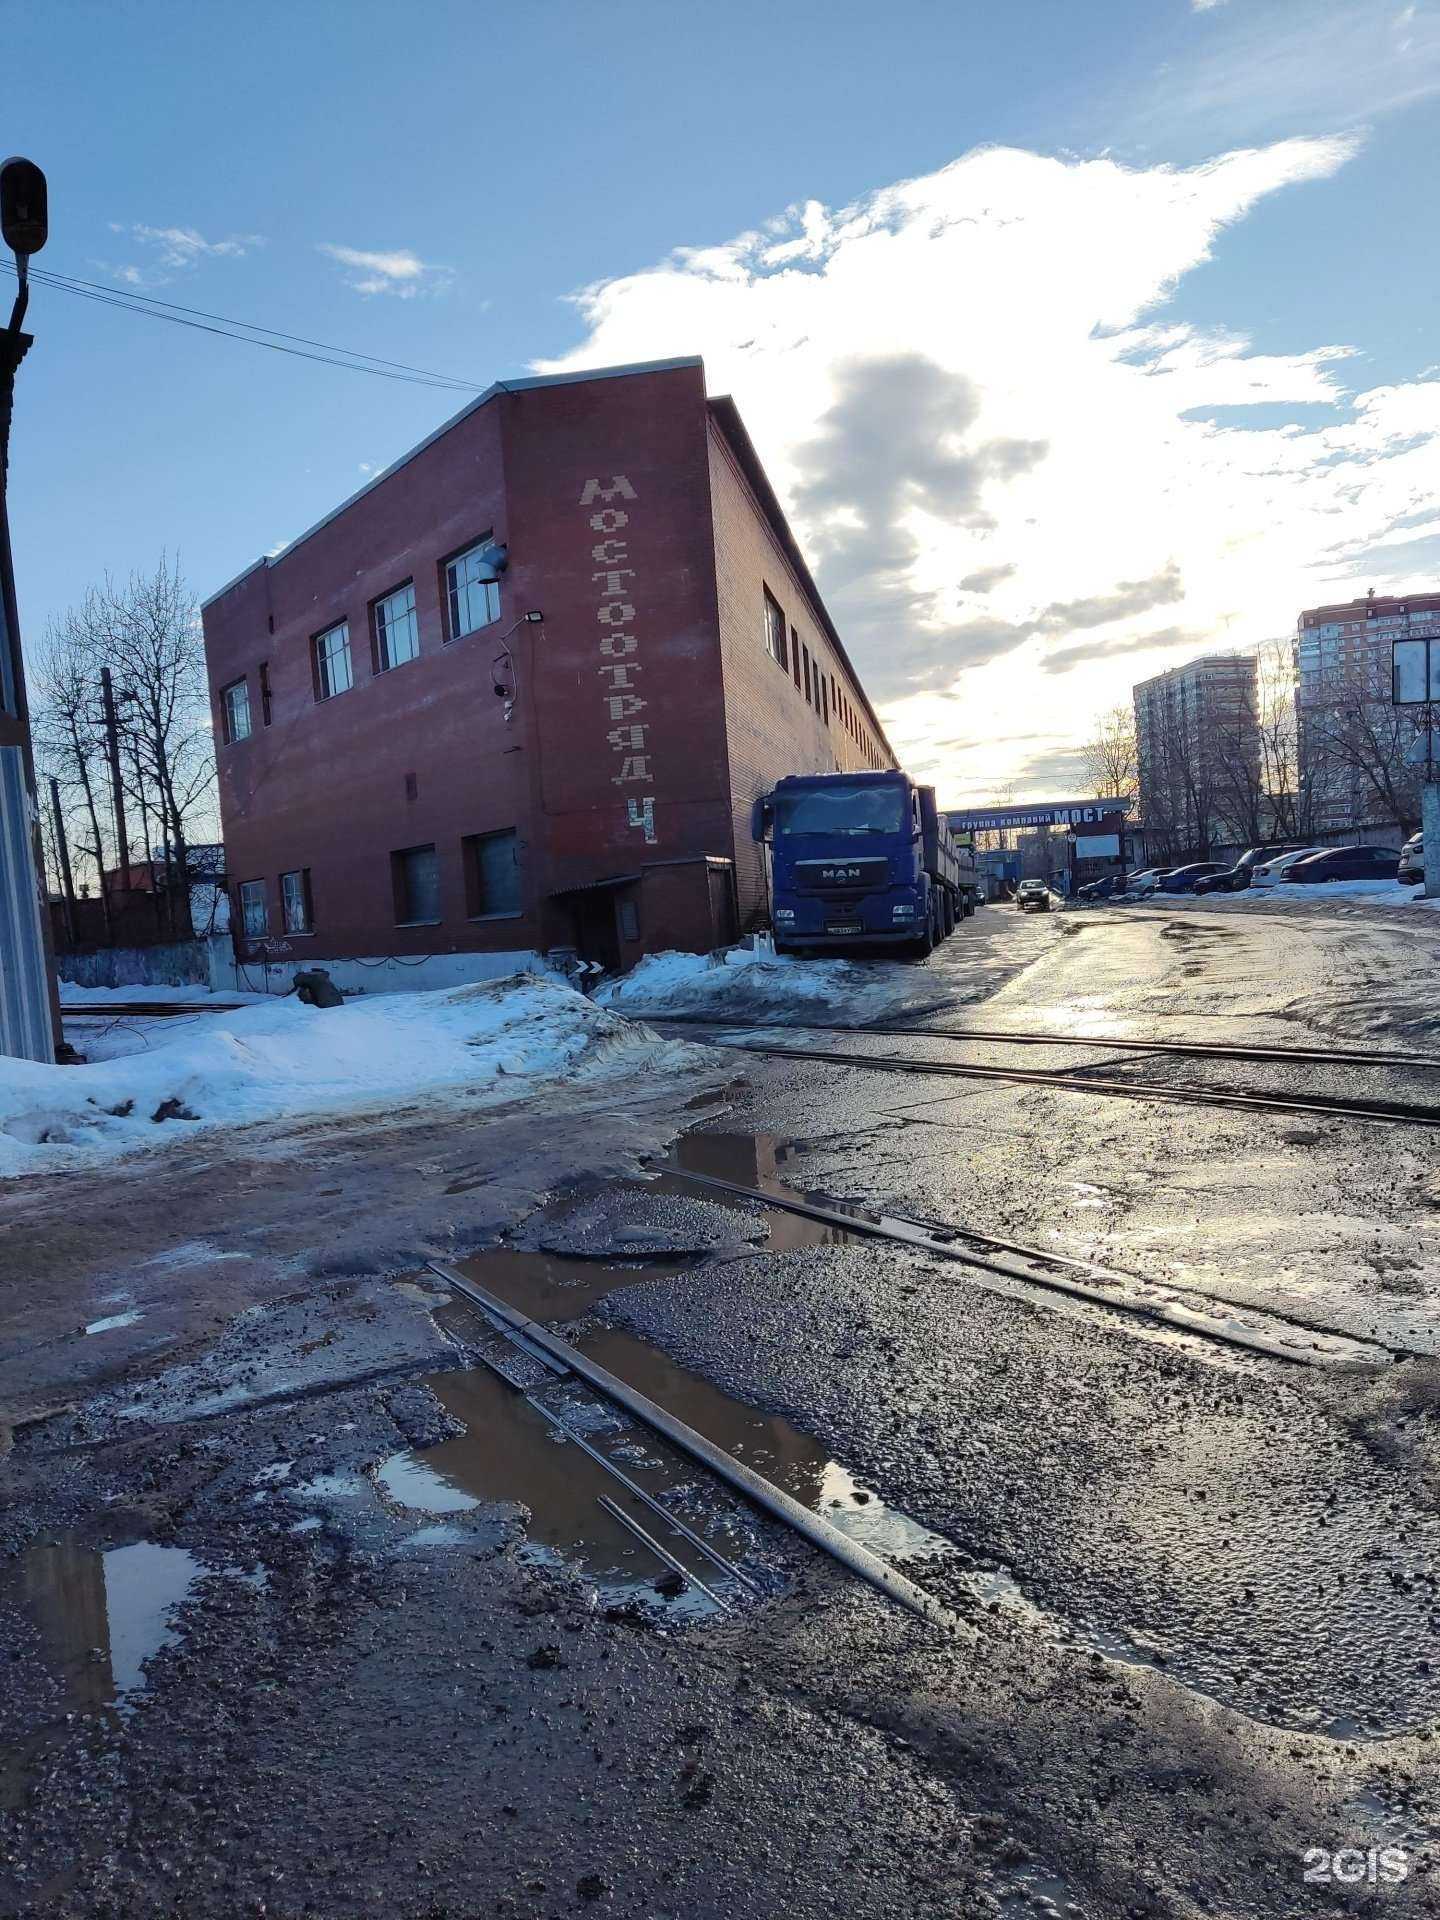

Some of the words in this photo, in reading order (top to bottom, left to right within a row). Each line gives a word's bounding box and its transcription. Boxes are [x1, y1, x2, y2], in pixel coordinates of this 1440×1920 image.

[579, 475, 653, 784] МОСТООТРЯД
[627, 797, 658, 844] 4
[1054, 807, 1106, 825] МОСТ
[822, 868, 861, 879] MAN
